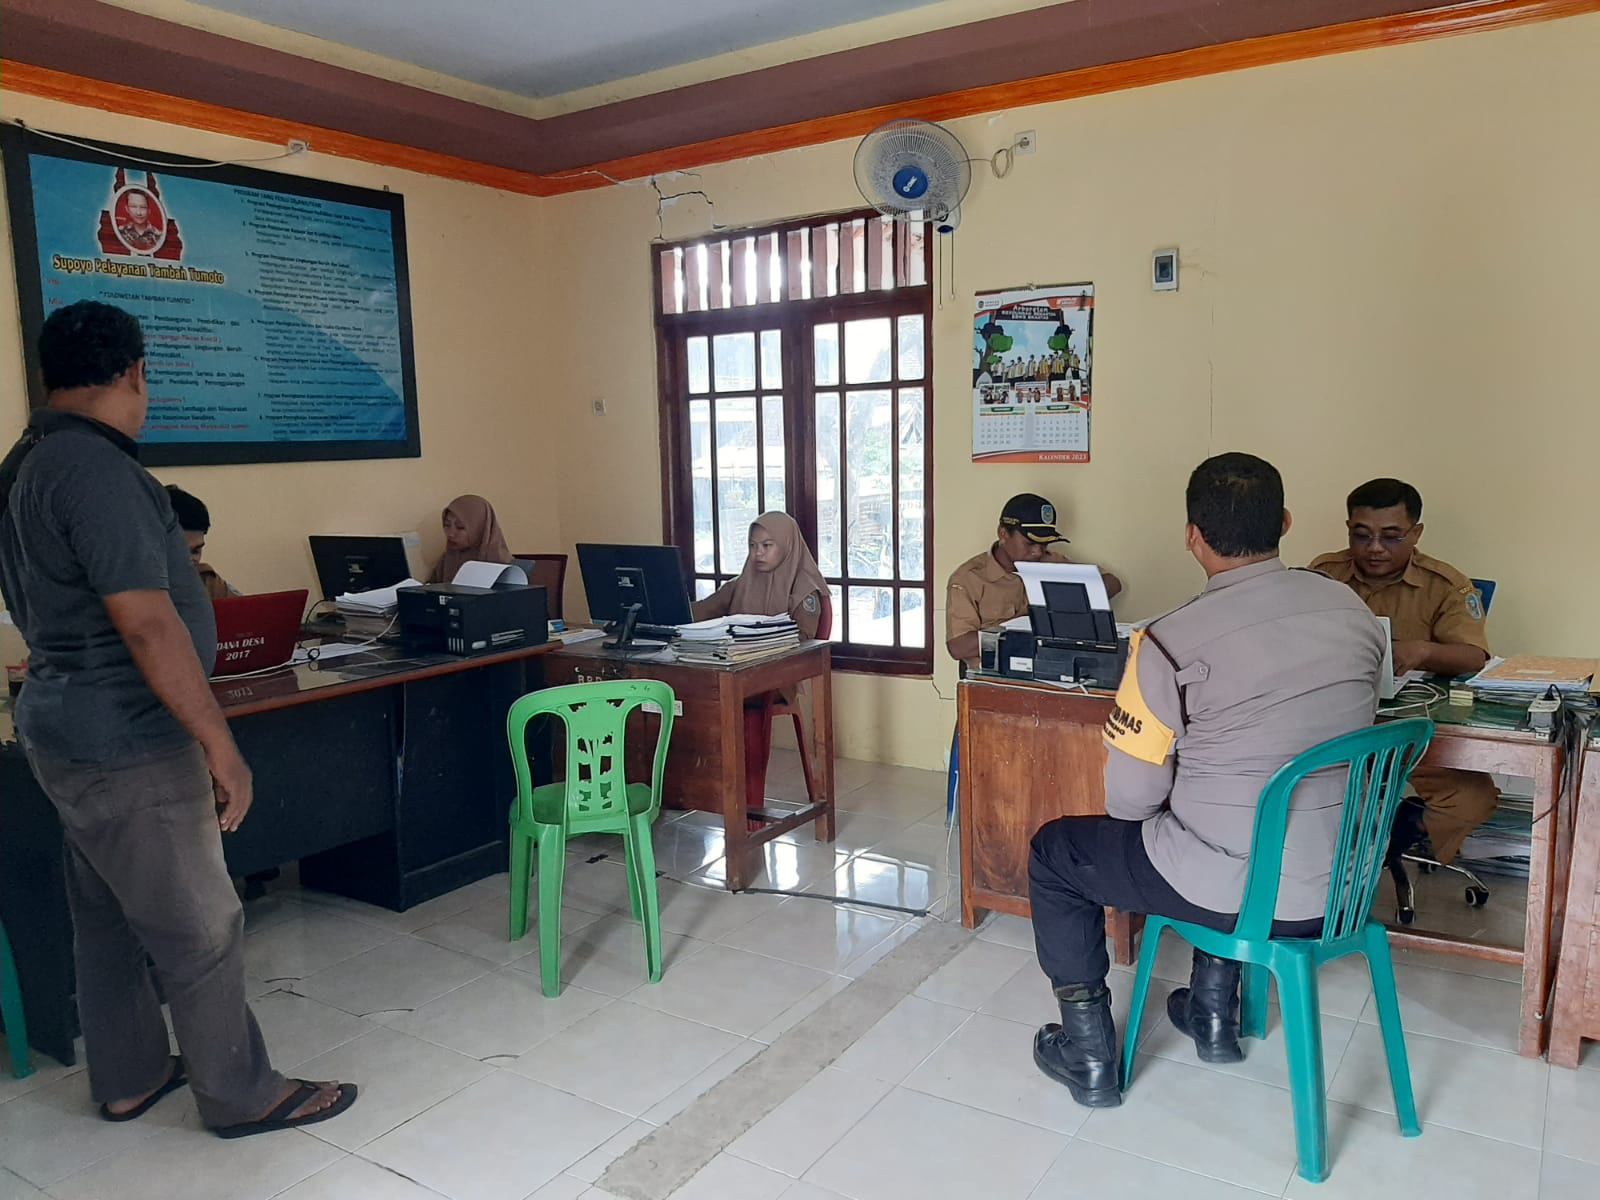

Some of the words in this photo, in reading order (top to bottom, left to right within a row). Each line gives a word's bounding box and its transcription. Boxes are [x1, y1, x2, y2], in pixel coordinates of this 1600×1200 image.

[53, 254, 94, 275] Supoyo
[94, 258, 148, 278] Pelayanan
[148, 262, 188, 280] Tambah
[188, 266, 225, 284] Tumoto
[242, 636, 265, 648] DESA
[225, 649, 251, 661] 2017
